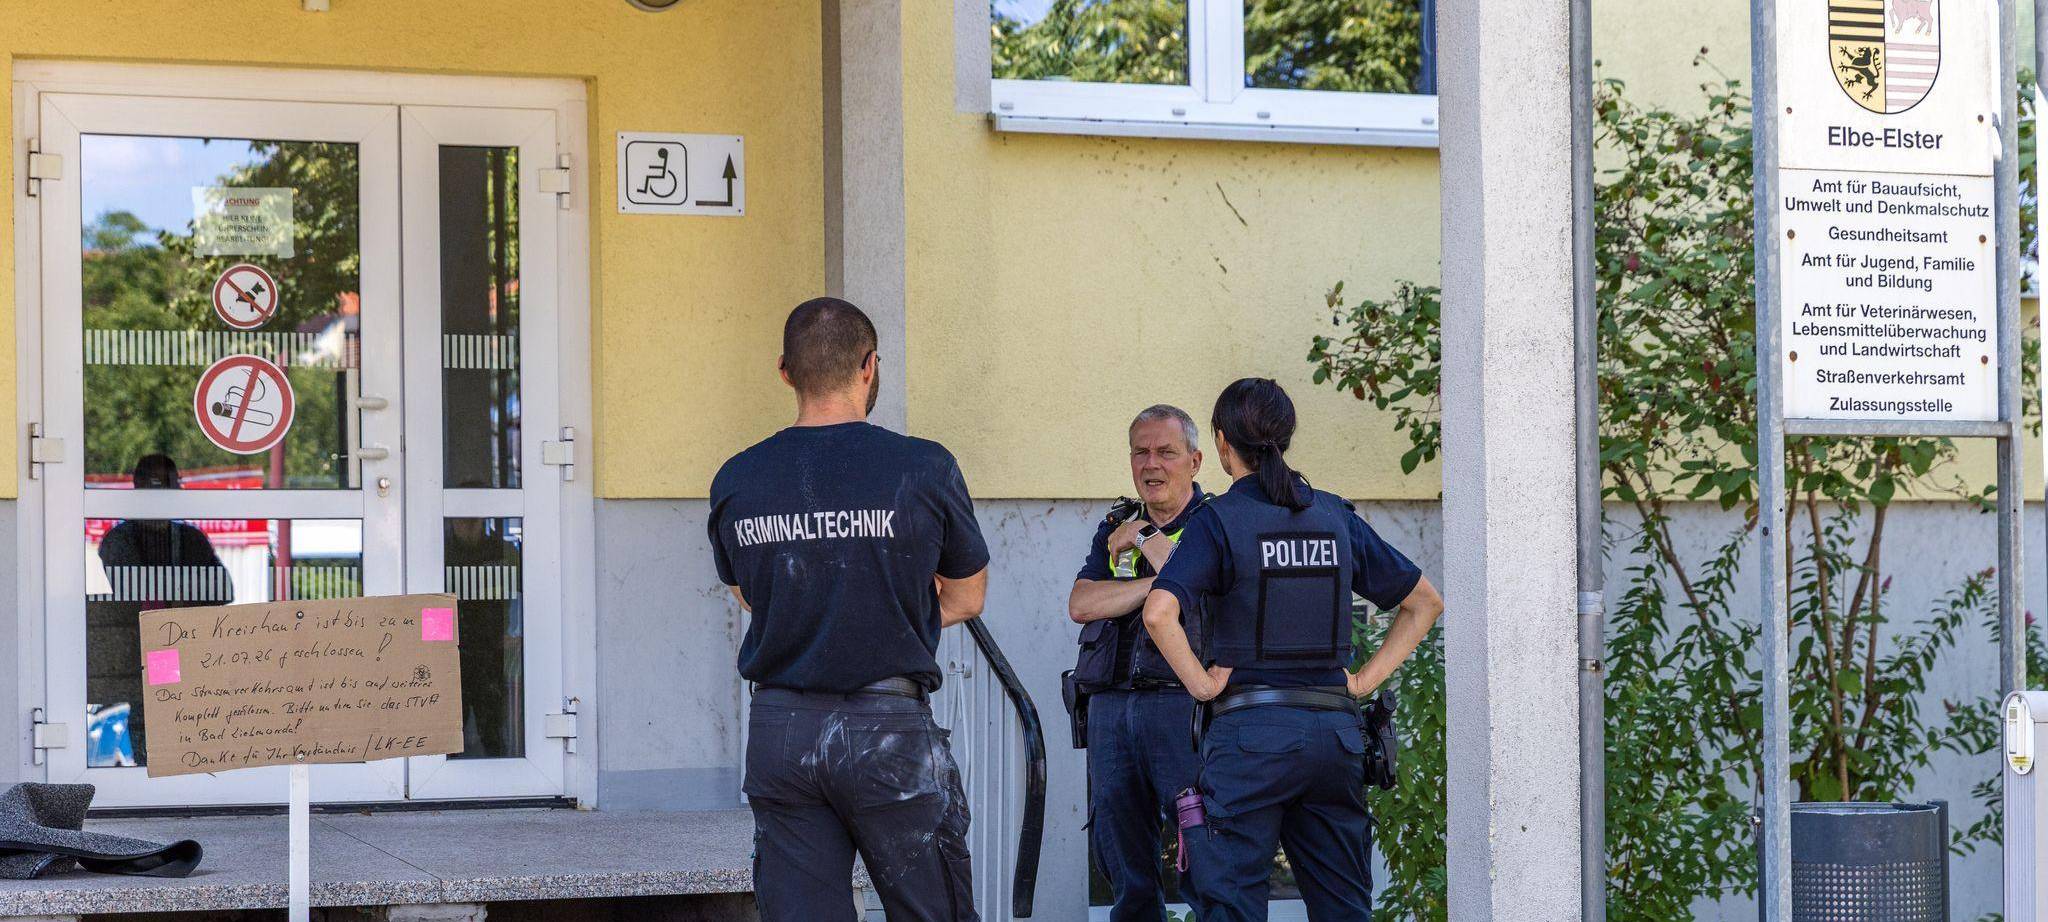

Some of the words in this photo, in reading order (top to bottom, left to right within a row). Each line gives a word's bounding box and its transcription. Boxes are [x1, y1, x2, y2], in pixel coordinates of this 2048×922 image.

[1828, 126, 1943, 149] Elbe-Elster
[1812, 178, 1842, 193] Amt
[1847, 180, 1867, 194] für
[1871, 181, 1962, 200] Bauaufsicht,
[1785, 196, 1841, 212] Umwelt
[1845, 199, 1873, 213] und
[1878, 201, 1989, 218] Denkmalschutz
[1828, 226, 1948, 243] Gesundheitsamt
[1801, 253, 1832, 267] Amt
[1836, 254, 1856, 268] für
[1860, 255, 1919, 272] Jugend,
[1923, 256, 1975, 271] Familie
[1845, 274, 1873, 288] und
[1878, 275, 1932, 292] Bildung
[1801, 303, 1832, 317] Amt
[1836, 304, 1856, 318] für
[1860, 305, 1977, 322] Veterinärwesen,
[1792, 322, 1987, 342] Lebensmittelüberwachung
[1819, 342, 1847, 356] und
[1852, 342, 1961, 358] Landwirtschaft
[1816, 369, 1966, 385] Straßenverkehrsamt
[1829, 397, 1953, 413] Zulassungsstelle
[734, 509, 895, 547] KRIMINALTECHNIK
[1261, 539, 1338, 568] POLIZEI
[159, 621, 196, 646] Das
[212, 610, 301, 638] Kreishaus
[316, 610, 340, 629] ist
[344, 610, 365, 629] bis
[200, 649, 273, 669] 21.07.26
[156, 688, 183, 701] Das
[320, 677, 335, 690] ist
[341, 676, 358, 689] bis
[282, 701, 314, 715] Bitte
[356, 698, 372, 709] Sie
[381, 696, 401, 710] das
[179, 732, 192, 743] in
[199, 728, 225, 742] Bad
